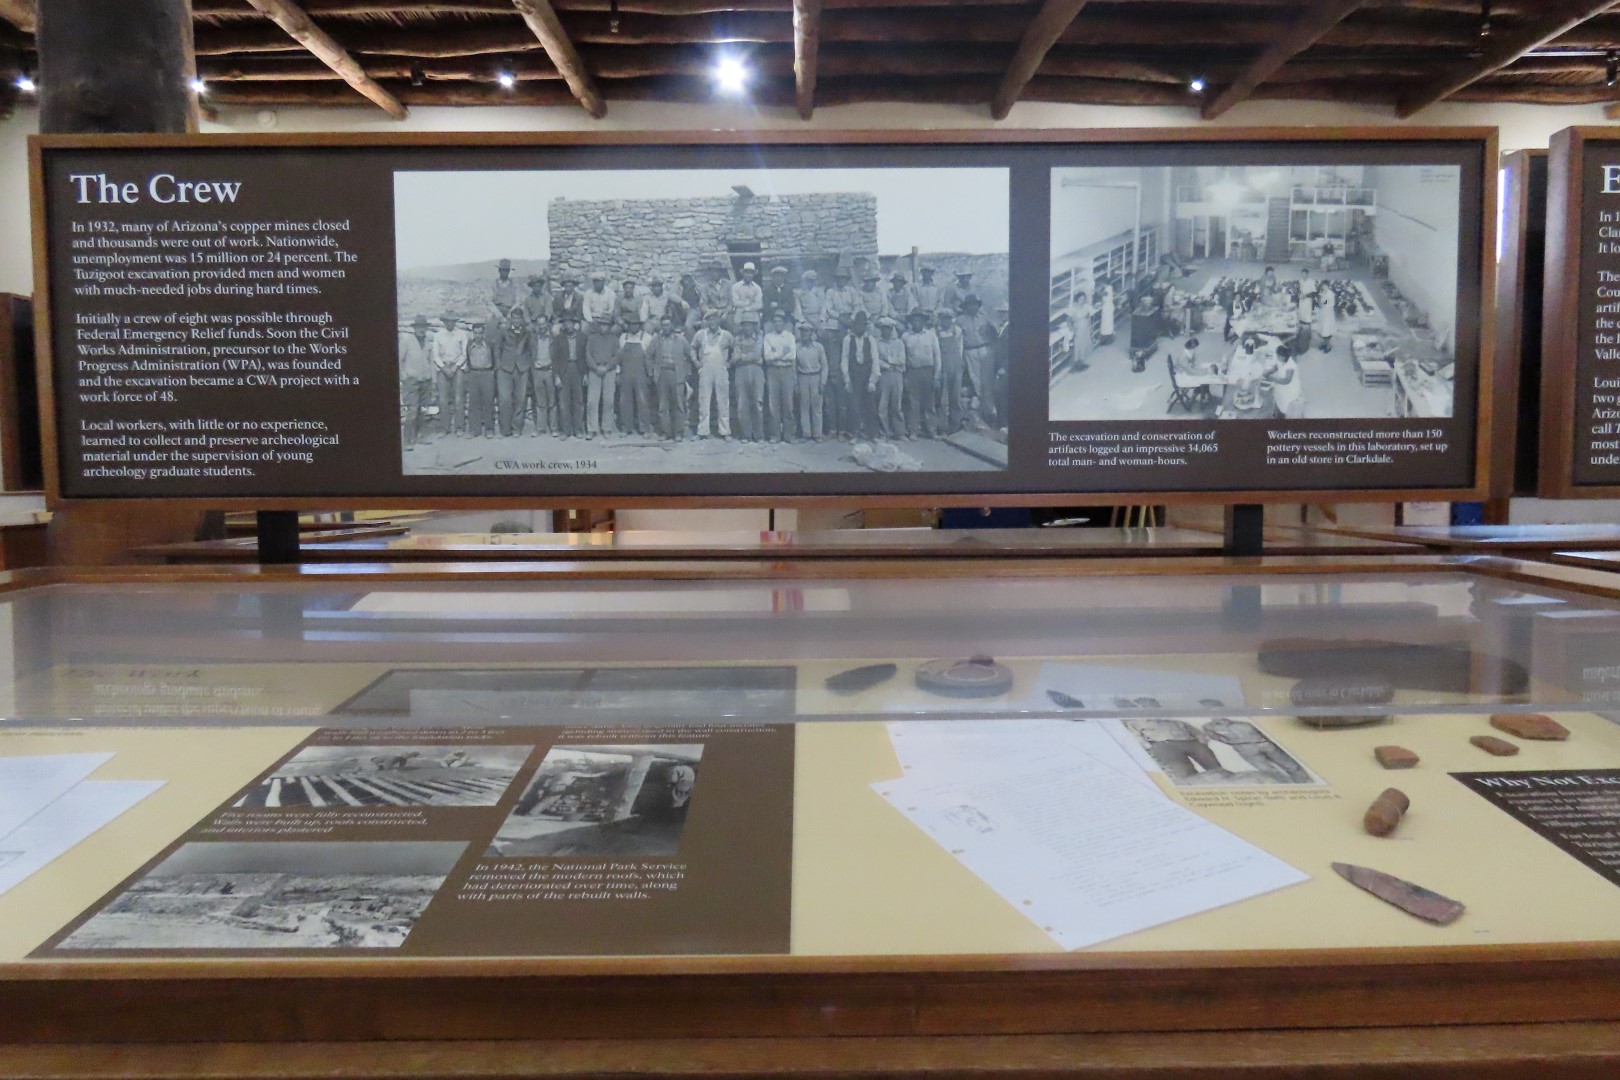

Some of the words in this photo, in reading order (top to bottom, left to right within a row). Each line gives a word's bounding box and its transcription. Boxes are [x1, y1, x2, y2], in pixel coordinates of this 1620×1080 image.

[70, 174, 139, 203] The
[149, 174, 241, 203] Crew
[1599, 211, 1611, 222] In
[72, 222, 85, 232] In
[88, 221, 119, 233] 1932,
[121, 224, 153, 235] many
[156, 221, 169, 231] of
[172, 221, 228, 232] Arizona's
[230, 223, 272, 234] copper
[274, 223, 310, 231] mines
[312, 220, 350, 231] closed
[72, 237, 95, 248] and
[97, 237, 158, 248] thousands
[161, 240, 189, 248] were
[192, 238, 211, 247] out
[214, 236, 227, 247] of
[229, 236, 263, 247] work.
[266, 235, 339, 247] Nationwide,
[1599, 242, 1607, 253] It
[73, 253, 162, 267] unemployment
[165, 255, 187, 263] was
[191, 252, 203, 263] 15
[206, 252, 248, 263] million
[267, 251, 281, 262] 24
[284, 253, 332, 265] percent.
[334, 251, 358, 262] The
[74, 269, 125, 282] Tuzigoot
[127, 270, 190, 279] excavation
[193, 268, 246, 282] provided
[277, 267, 299, 278] and
[302, 270, 345, 278] women
[74, 285, 101, 295] with
[103, 284, 184, 295] much-needed
[187, 284, 212, 297] jobs
[214, 283, 254, 297] during
[256, 283, 284, 294] hard
[286, 284, 322, 294] times.
[76, 313, 121, 327] Initially
[124, 316, 131, 324] a
[133, 316, 162, 324] crew
[164, 313, 177, 323] of
[179, 313, 208, 326] eight
[235, 312, 283, 326] possible
[286, 312, 333, 326] through
[77, 328, 120, 340] Federal
[123, 329, 188, 342] Emergency
[191, 328, 226, 339] Relief
[228, 328, 264, 338] funds.
[266, 328, 297, 338] Soon
[300, 328, 318, 338] the
[321, 327, 349, 338] Civil
[77, 345, 116, 355] Works
[118, 344, 210, 355] Administration,
[213, 346, 270, 357] precursor
[273, 345, 285, 354] to
[288, 343, 306, 354] the
[309, 343, 347, 354] Works
[79, 360, 129, 373] Progress
[131, 360, 220, 370] Administration
[222, 359, 265, 370] (WPA),
[267, 362, 290, 370] was
[292, 359, 341, 369] founded
[79, 376, 101, 386] and
[104, 376, 122, 386] the
[125, 378, 187, 386] excavation
[189, 375, 234, 386] became
[246, 375, 277, 385] CWA
[280, 375, 321, 388] project
[324, 374, 350, 385] with
[353, 377, 359, 385] a
[79, 391, 110, 402] work
[113, 391, 142, 402] force
[145, 391, 158, 401] of
[160, 391, 177, 402] 48.
[1593, 394, 1614, 403] two
[81, 420, 114, 430] Local
[116, 420, 167, 430] workers,
[169, 419, 195, 430] with
[198, 419, 224, 430] little
[260, 422, 328, 432] experience,
[1591, 423, 1611, 434] call
[1048, 433, 1068, 441] The
[1121, 432, 1140, 440] and
[1141, 433, 1203, 441] conservation
[1204, 431, 1215, 440] of
[1267, 431, 1307, 439] Workers
[1309, 430, 1374, 439] reconstructed
[1402, 430, 1423, 438] than
[1427, 429, 1443, 438] 150
[82, 435, 126, 446] learned
[129, 437, 141, 445] to
[143, 435, 181, 445] collect
[184, 435, 206, 445] and
[209, 438, 259, 448] preserve
[261, 434, 339, 448] archeological
[1591, 440, 1619, 449] most
[1048, 445, 1087, 454] artifacts
[1089, 444, 1120, 455] logged
[1136, 446, 1185, 455] impressive
[1188, 444, 1218, 453] 34,065
[1267, 445, 1301, 454] pottery
[1303, 442, 1335, 452] vessels
[1348, 442, 1366, 451] this
[1367, 442, 1418, 451] laboratory,
[1435, 444, 1448, 453] up
[83, 451, 130, 461] material
[133, 450, 168, 461] under
[170, 450, 189, 461] the
[192, 453, 259, 463] supervision
[262, 450, 275, 460] of
[277, 453, 314, 463] young
[1048, 457, 1070, 466] total
[1098, 457, 1117, 465] and
[1118, 456, 1187, 465] woman-hours.
[1291, 455, 1307, 464] old
[1345, 454, 1393, 464] Clarkdale.
[494, 461, 520, 470] CWA
[521, 461, 546, 469] work
[576, 460, 597, 469] 1934
[83, 466, 147, 479] archeology
[150, 466, 201, 479] graduate
[203, 465, 255, 476] students.
[1475, 777, 1531, 788] Why
[1530, 777, 1580, 786] Not
